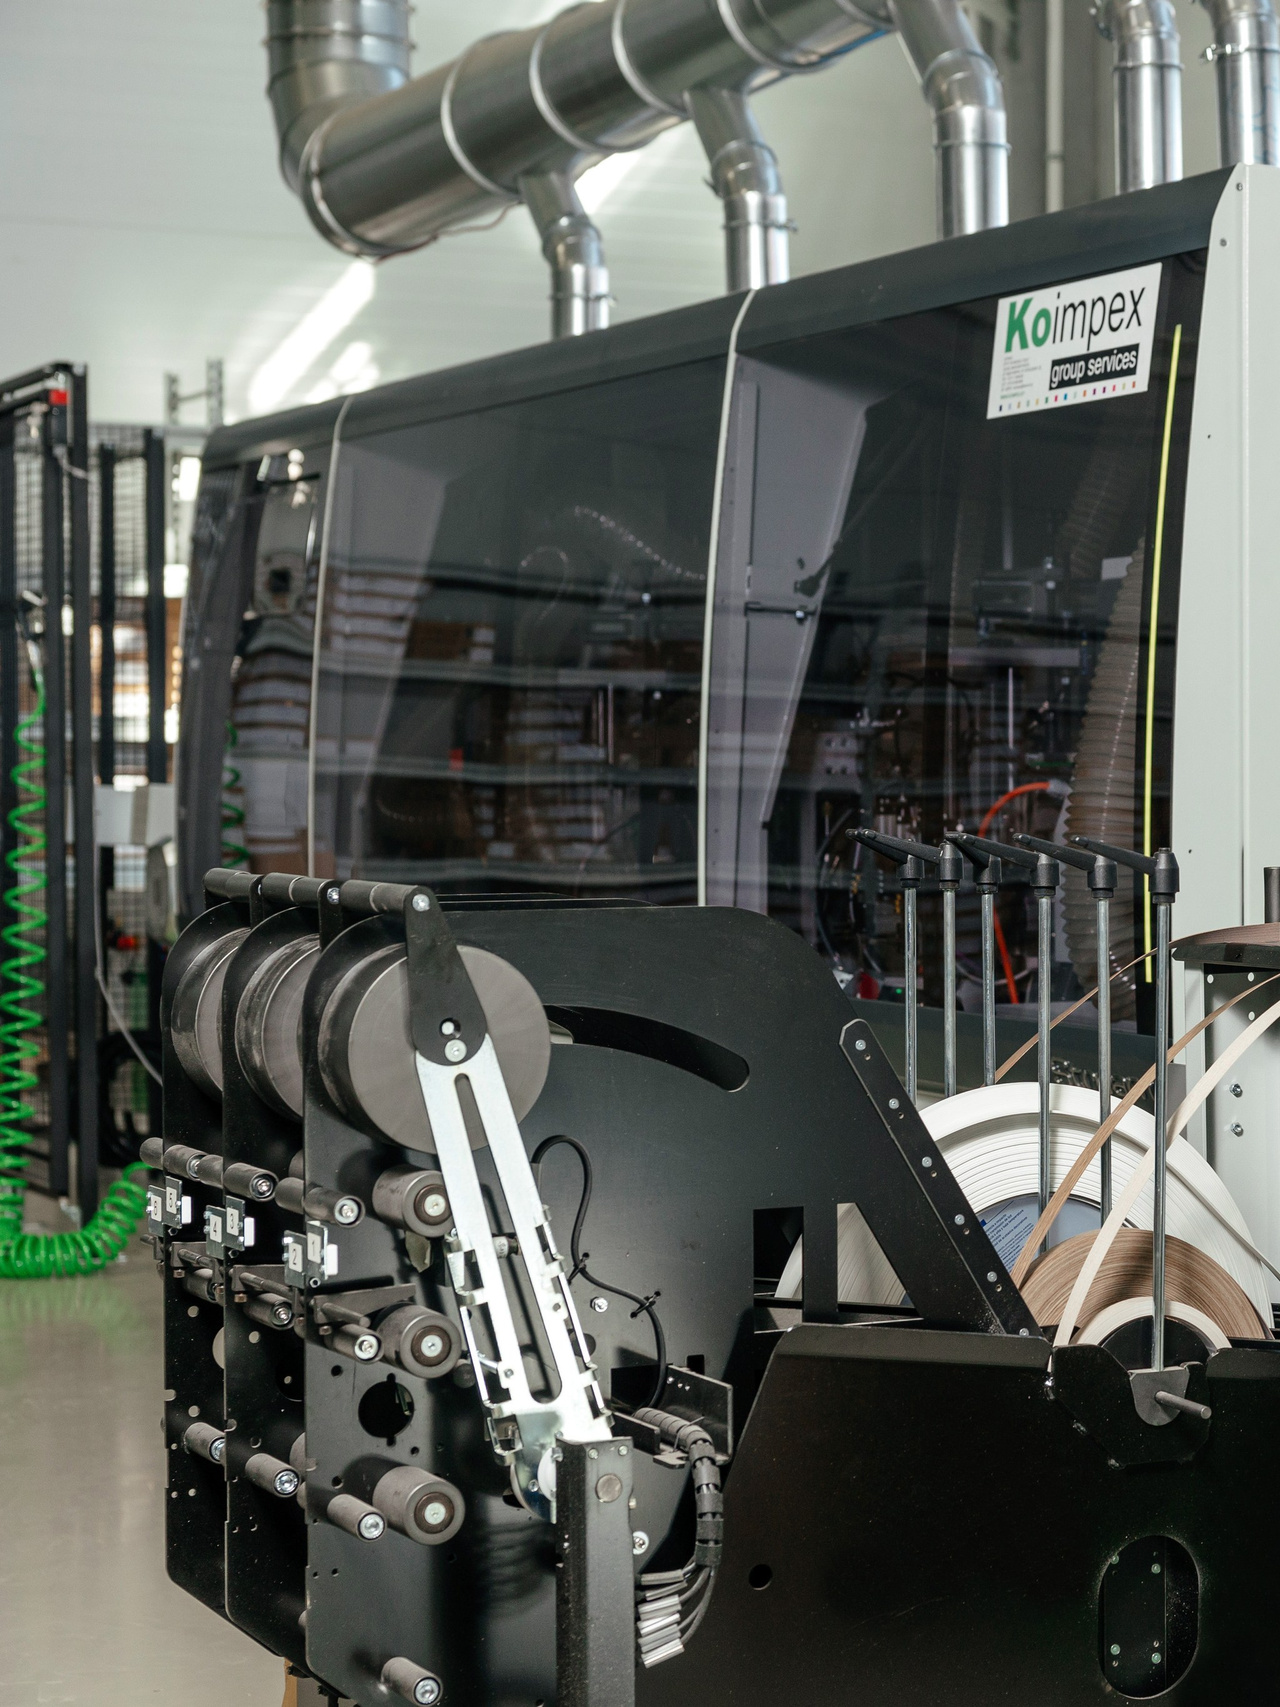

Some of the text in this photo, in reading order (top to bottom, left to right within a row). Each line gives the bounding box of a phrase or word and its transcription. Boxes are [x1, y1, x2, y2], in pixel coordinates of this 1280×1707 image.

[1005, 287, 1146, 353] Koimpex
[1051, 361, 1085, 388] group
[1087, 350, 1137, 376] services
